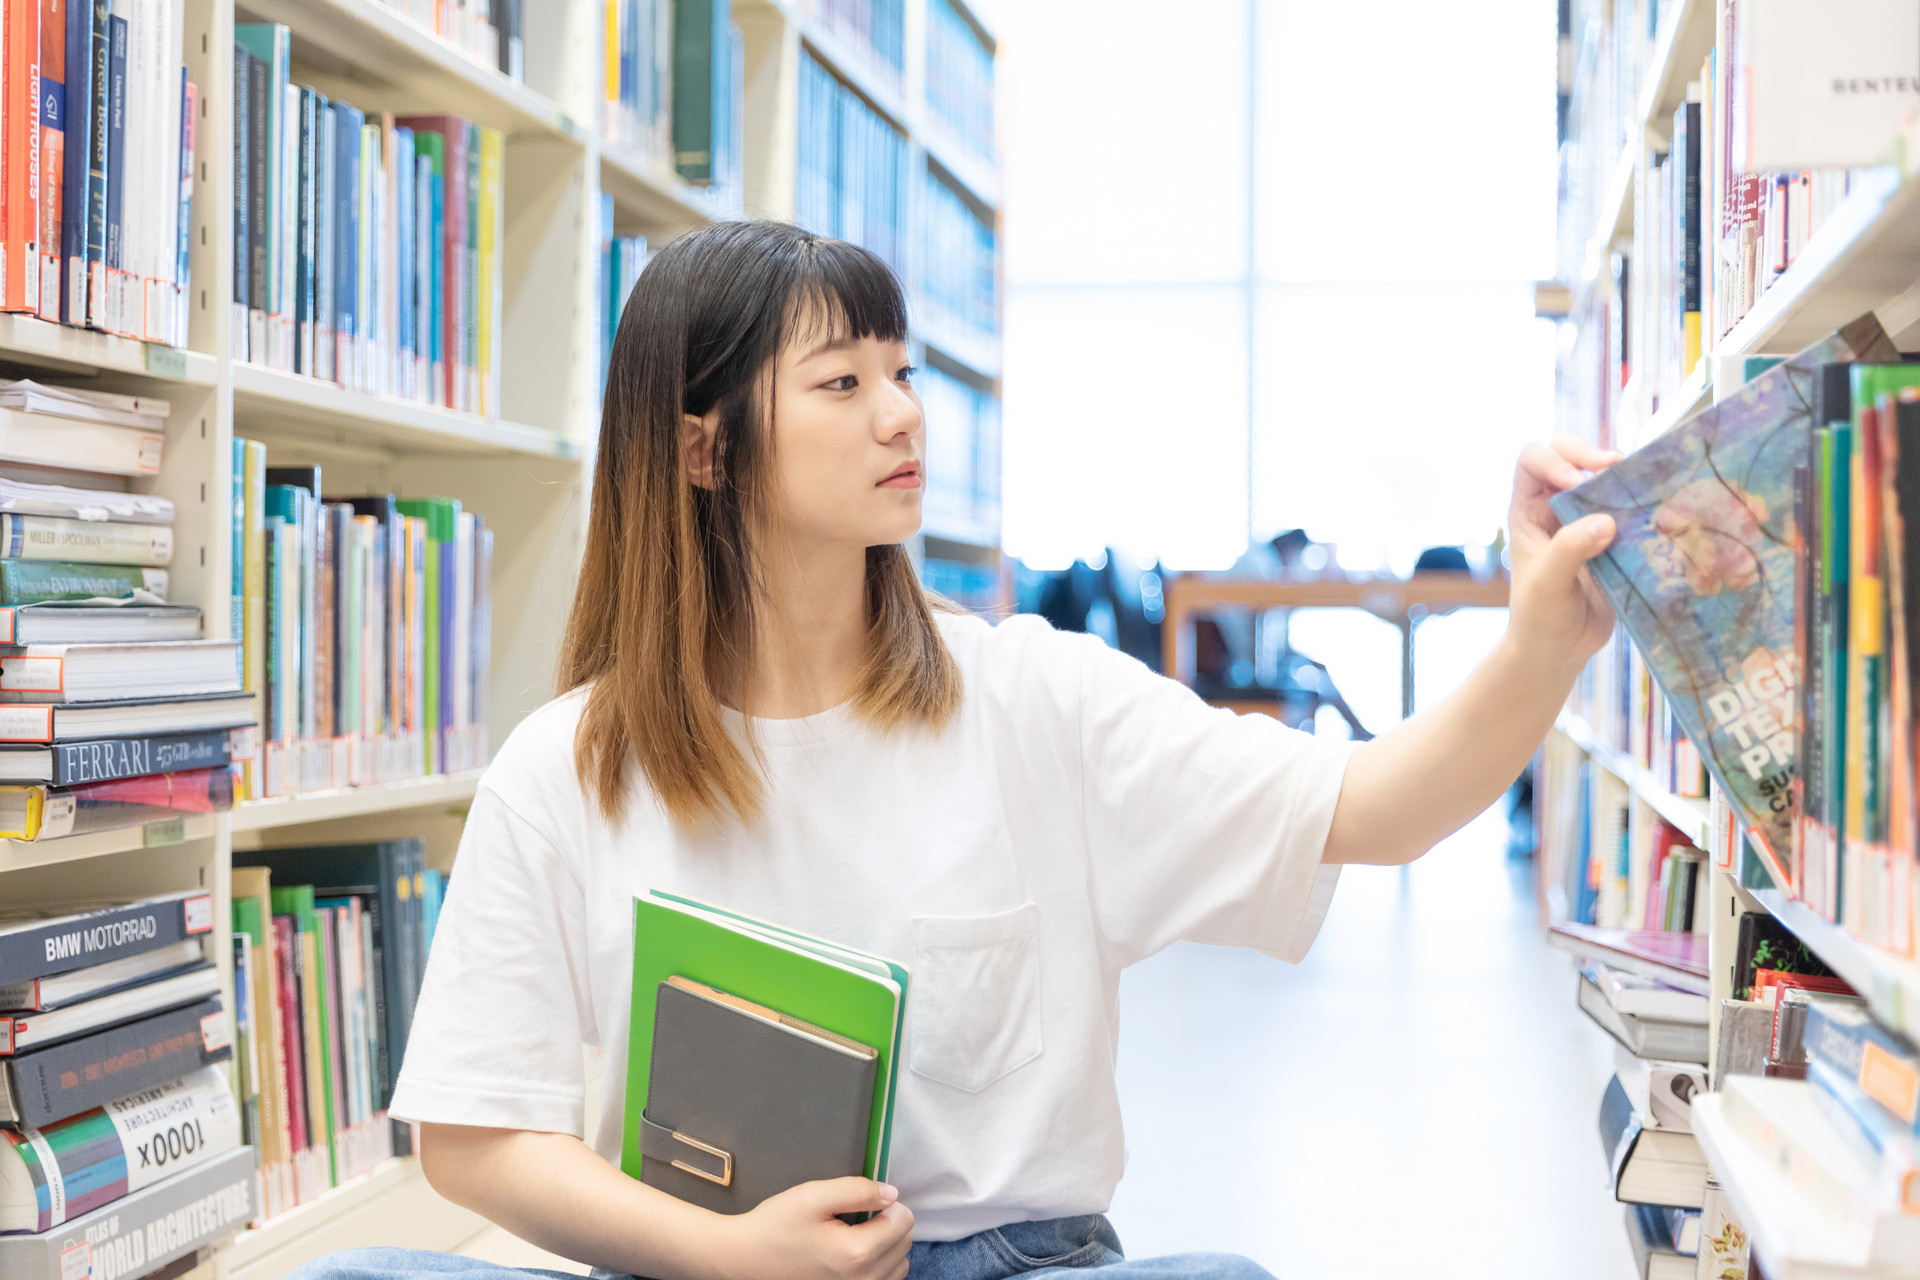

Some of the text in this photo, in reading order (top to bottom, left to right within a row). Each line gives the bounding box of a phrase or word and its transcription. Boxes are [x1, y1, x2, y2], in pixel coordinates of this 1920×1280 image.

[47, 185, 55, 206] Ship
[30, 531, 56, 545] MILLER
[1707, 653, 1795, 726] DIGI
[66, 739, 151, 783] FERRARI
[1758, 765, 1795, 797] SU
[45, 915, 158, 962] BMW MOTORRAD
[111, 1087, 162, 1114] AMERICAS
[124, 1095, 194, 1132] ARCHITECTURE
[85, 1220, 110, 1245] ATLAS
[146, 1178, 252, 1262] ARCHITECTURE
